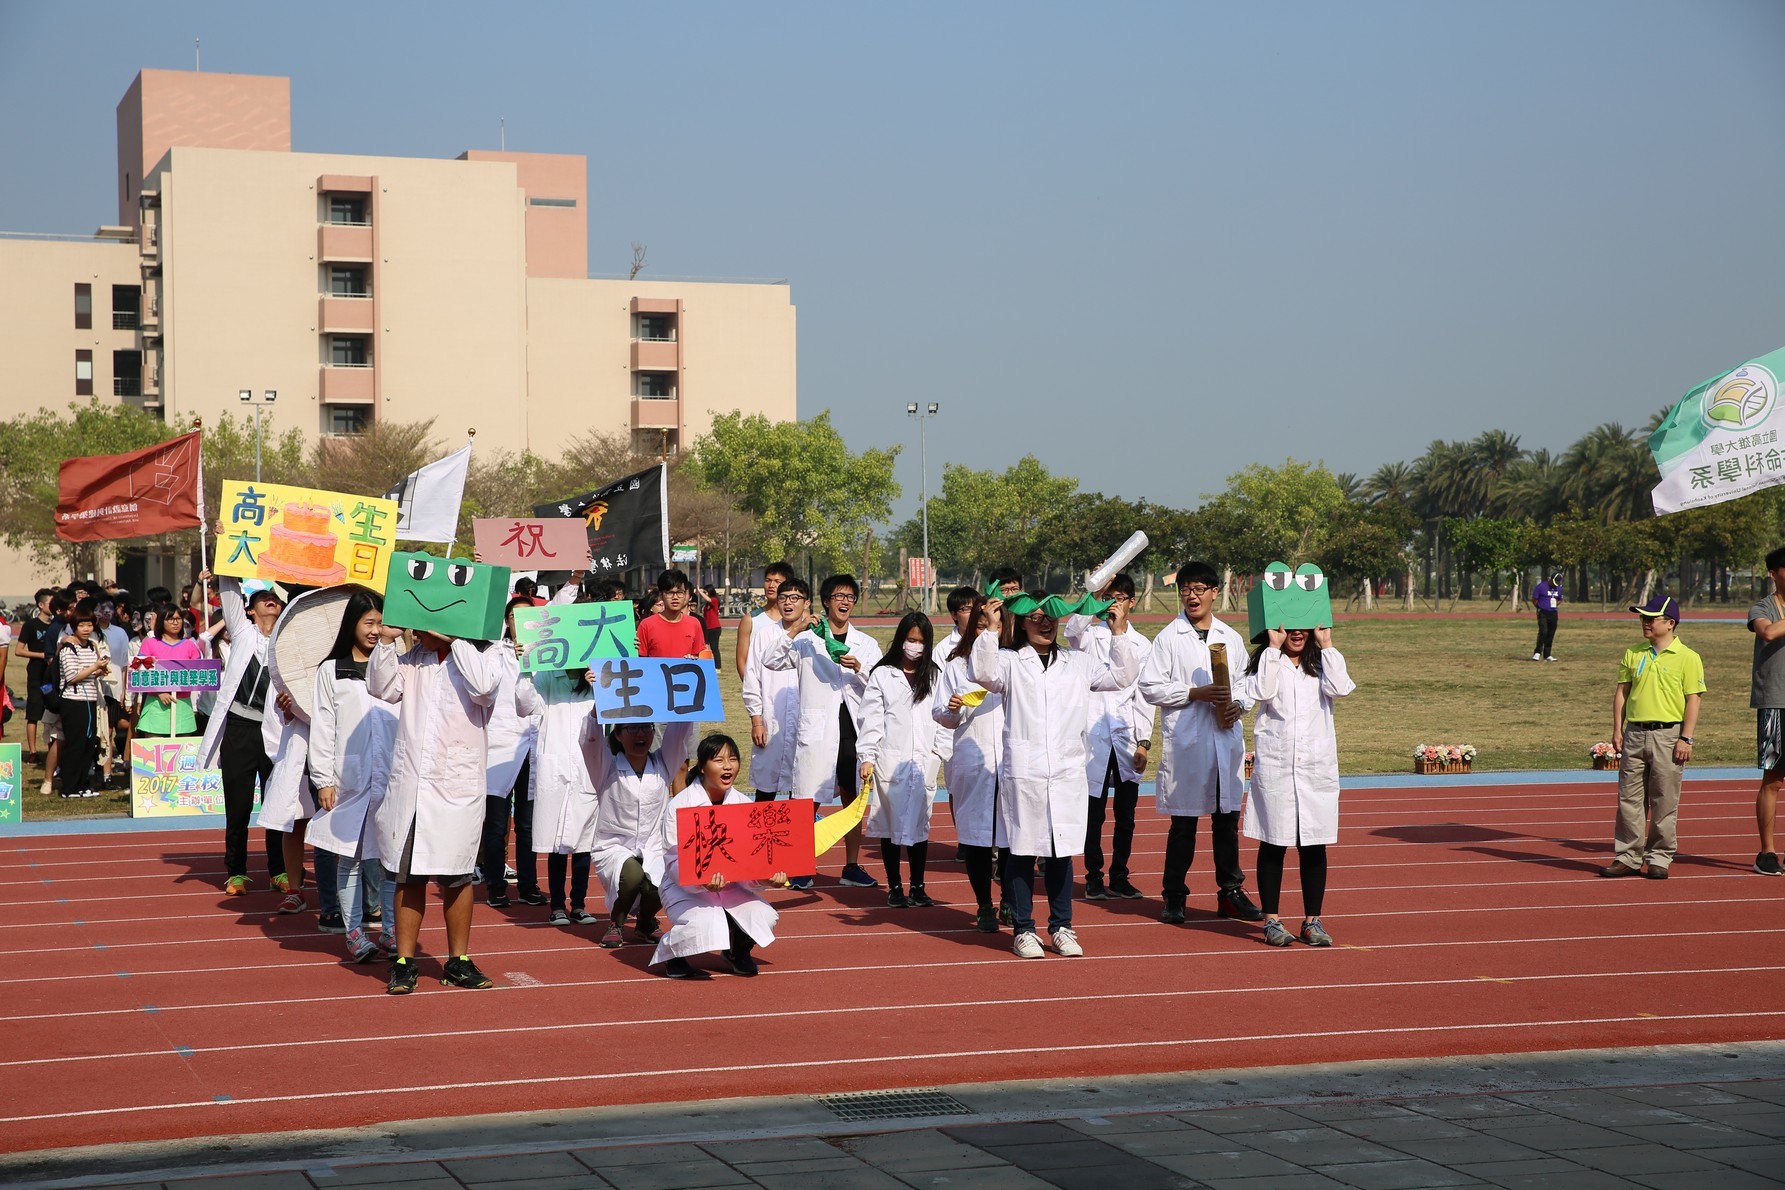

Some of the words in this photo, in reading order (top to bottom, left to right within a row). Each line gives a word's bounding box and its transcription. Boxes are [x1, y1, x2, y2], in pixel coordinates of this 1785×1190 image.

[500, 521, 557, 558] 祝
[522, 605, 634, 669] 高大
[131, 669, 217, 687] 創意設計與建築學系
[600, 659, 707, 720] 生日
[154, 743, 182, 773] 17
[138, 775, 177, 794] 2017
[684, 802, 794, 878] 快樂
